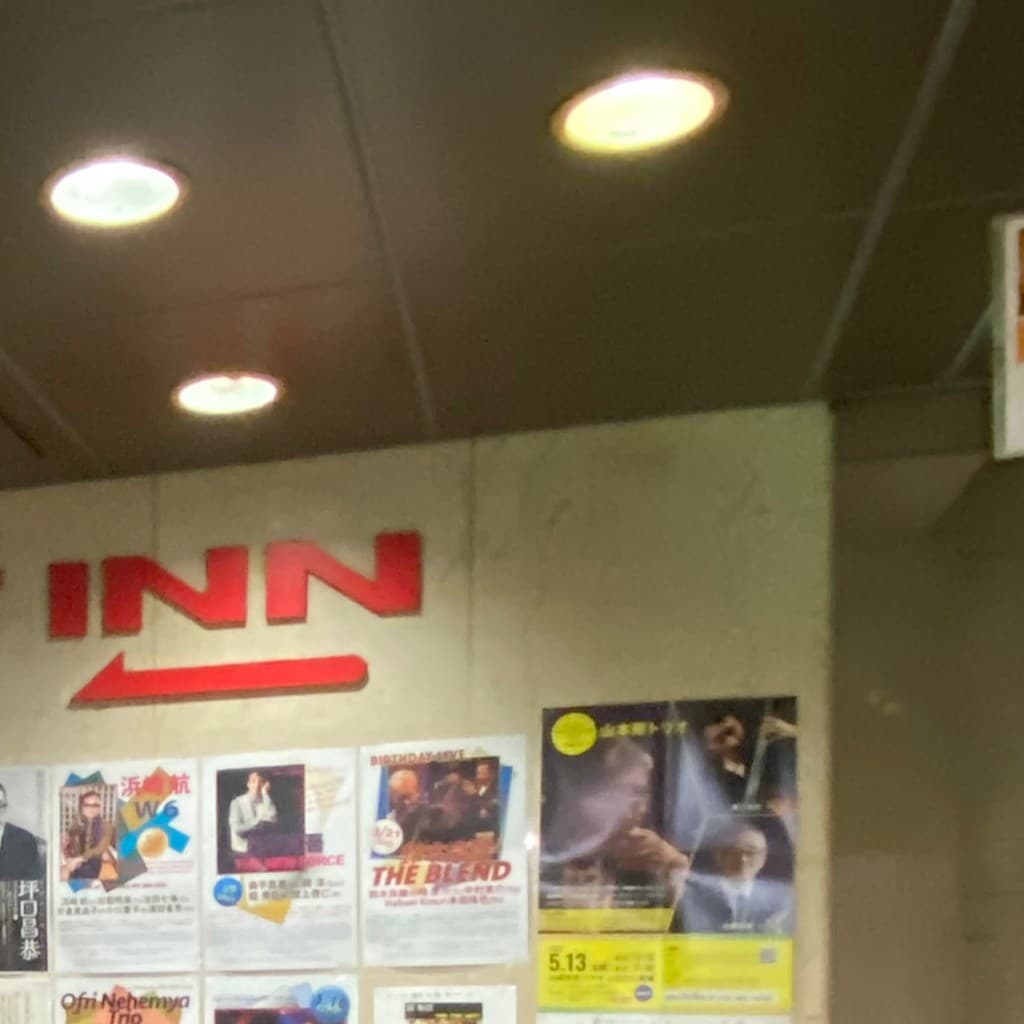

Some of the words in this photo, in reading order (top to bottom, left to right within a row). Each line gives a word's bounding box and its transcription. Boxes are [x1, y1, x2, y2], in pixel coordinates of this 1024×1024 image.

[47, 530, 423, 640] INN
[372, 865, 420, 886] THE
[425, 860, 512, 885] BLEND
[548, 952, 587, 972] 5.13
[61, 992, 98, 1015] Ofri
[101, 992, 190, 1014] Nehemya
